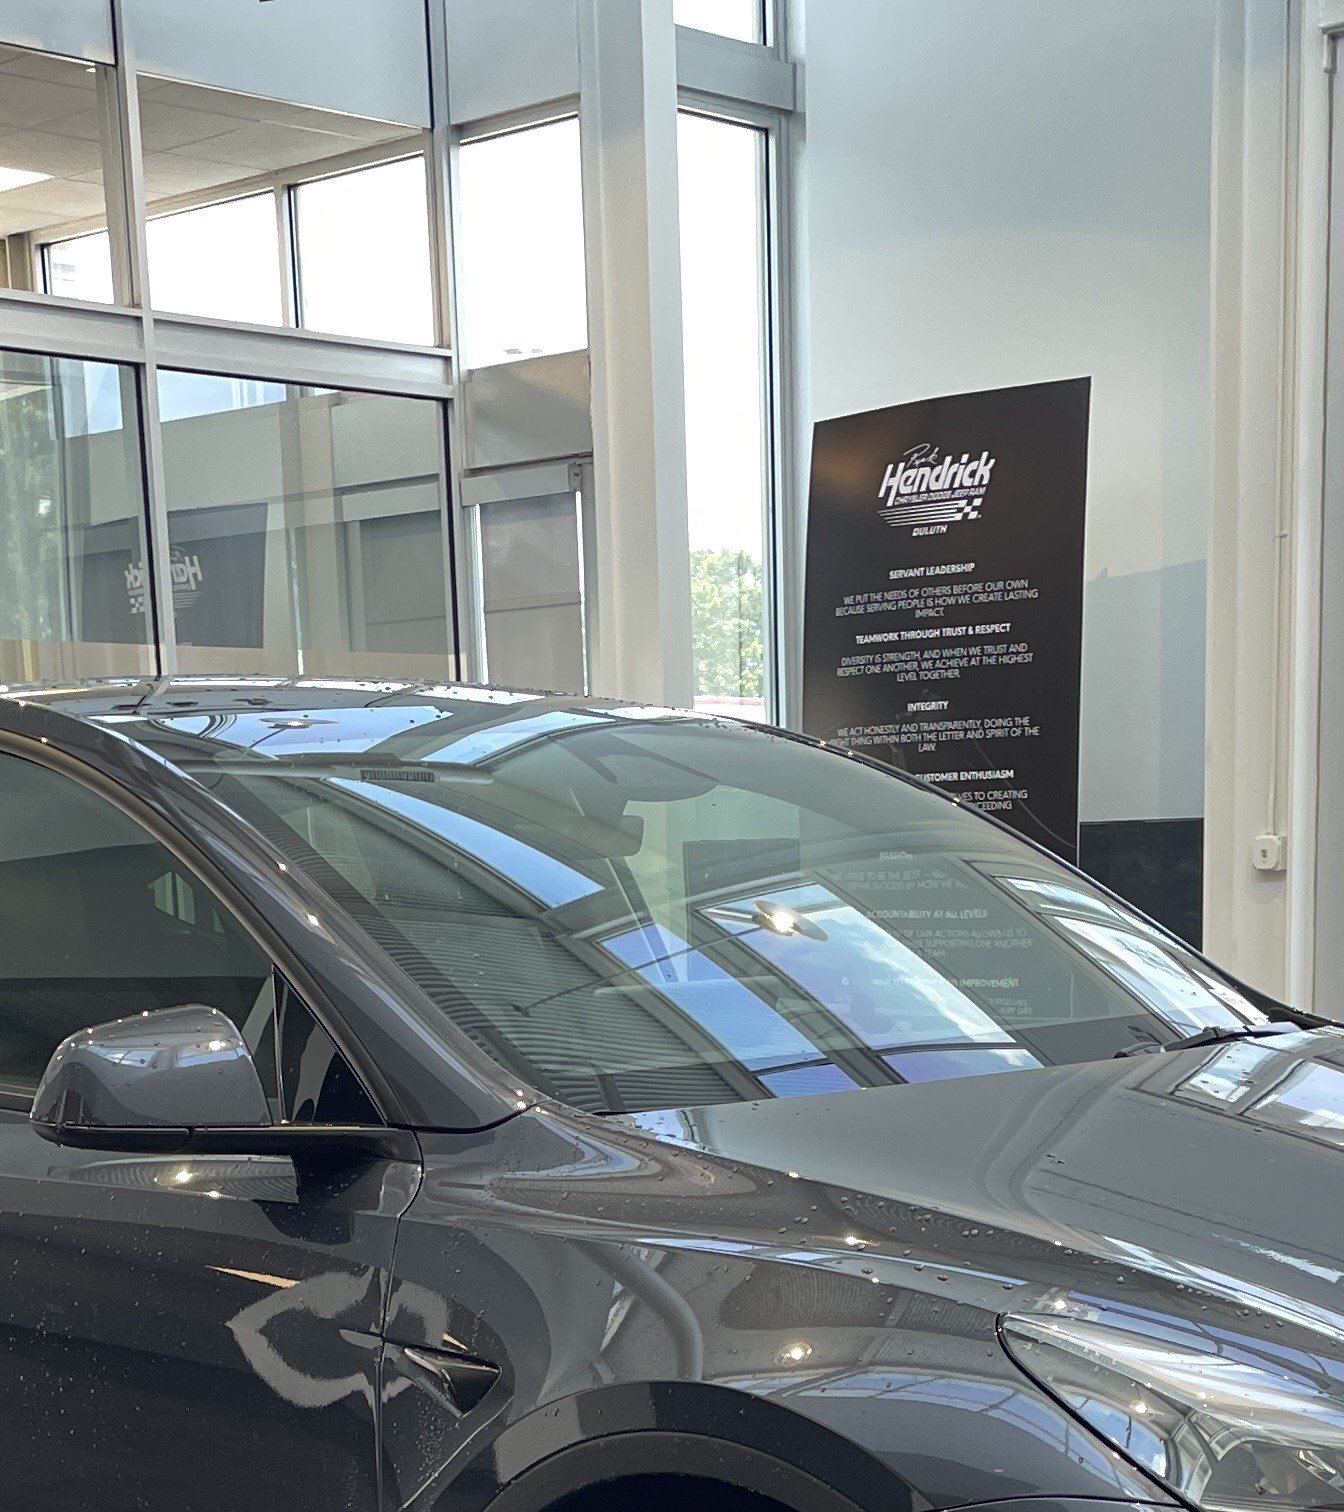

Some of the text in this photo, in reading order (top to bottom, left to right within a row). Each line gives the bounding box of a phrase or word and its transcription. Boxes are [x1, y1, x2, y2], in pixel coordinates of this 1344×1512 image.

[878, 451, 996, 507] Hendrick
[912, 524, 948, 537] DULUTH
[889, 563, 975, 580] SERVANT LEADERSHIP
[843, 579, 1028, 605] WE PUT THE NEEDS OF OTHERS BEFORE OUR OWN
[836, 588, 1039, 617] BECAUSE SERVING PEOPLE IS HOW WE CREATE LASTING
[855, 622, 1011, 645] TEAMWORK THROUGH TRUST & RESPECT
[841, 654, 874, 666] DIVERSITY
[874, 654, 882, 663] IS
[923, 649, 941, 659] AND
[942, 647, 968, 658] WHEN
[968, 646, 982, 656] WE
[983, 644, 1008, 655] TRUST
[1008, 642, 1028, 653] AND
[836, 665, 865, 677] RESPECT
[865, 664, 882, 675] ONE
[920, 660, 933, 669] WE
[934, 657, 969, 669] ACHIEVE
[970, 656, 981, 666] AT
[982, 655, 997, 665] THE
[998, 652, 1034, 664] HIGHEST
[896, 672, 917, 682] LEVEL
[907, 701, 949, 712] INTEGRITY
[849, 726, 863, 736] ACT
[863, 724, 900, 735] HONESTLY
[901, 723, 918, 733] AND
[984, 717, 1013, 728] DOING
[1014, 716, 1030, 726] THE
[851, 736, 872, 745] THING
[900, 733, 922, 744] BOTH
[922, 732, 937, 742] THE
[939, 731, 965, 741] LETTER
[965, 729, 984, 739] AND
[985, 728, 1009, 738] SPIRIT
[1010, 727, 1023, 737] OF
[1024, 726, 1040, 736] THE
[916, 769, 1014, 782] CUSTOMER ENTHUSIASM
[974, 791, 985, 800] TO
[987, 789, 1028, 800] CREATING
[976, 801, 1012, 811] CEEDING
